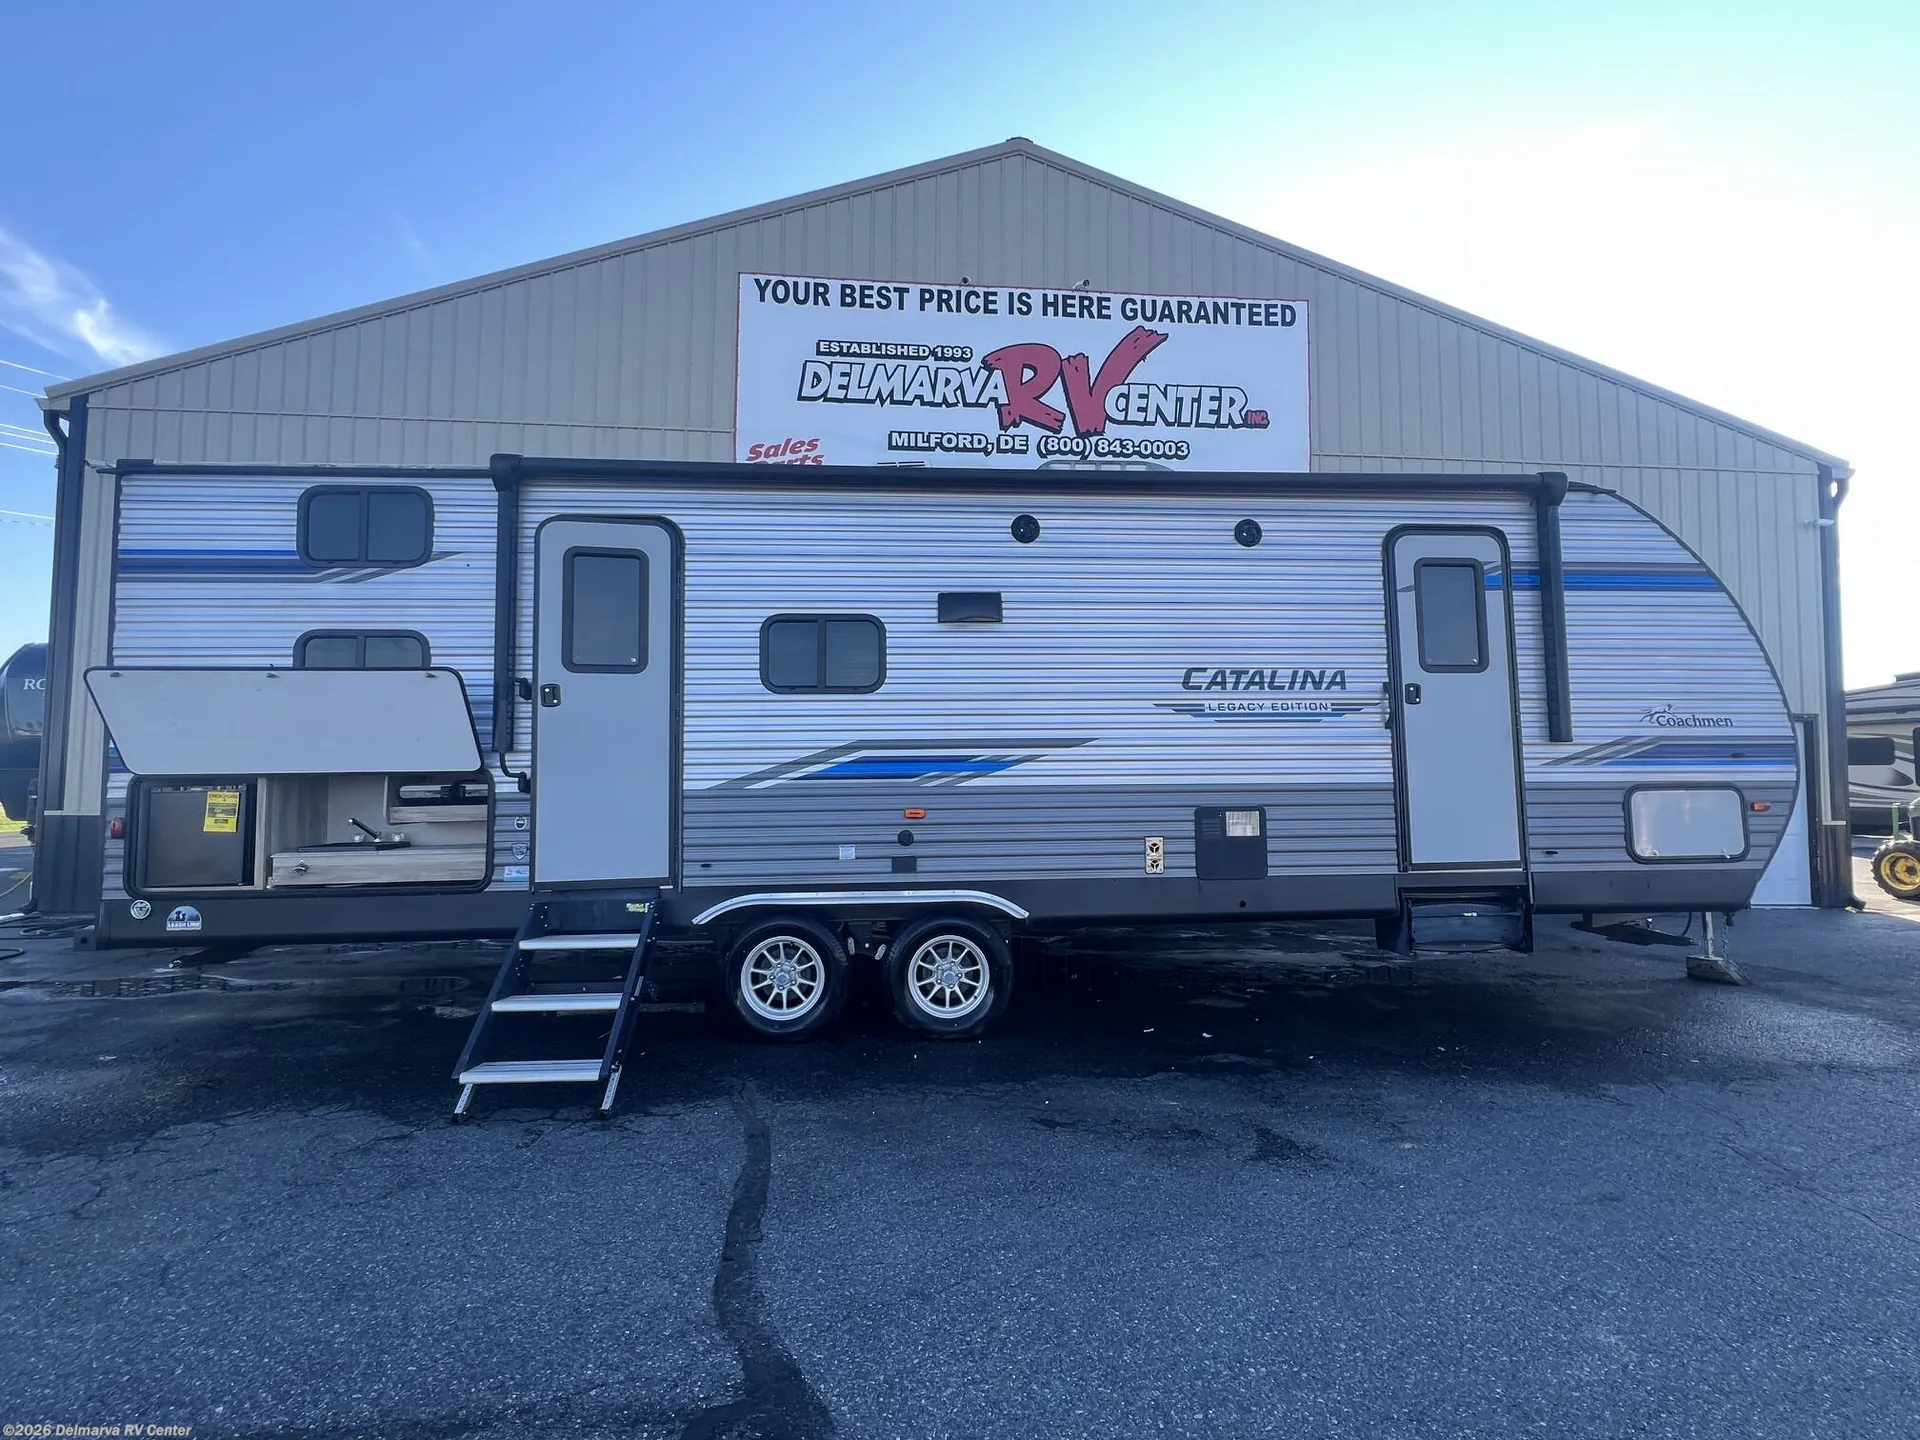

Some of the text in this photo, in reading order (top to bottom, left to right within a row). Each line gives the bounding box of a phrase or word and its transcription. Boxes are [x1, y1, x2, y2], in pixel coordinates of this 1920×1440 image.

[754, 278, 1297, 327] YOUR BEST PRICE IS HERE GUARANTEED
[817, 340, 973, 360] ESTABLISHED 1993
[797, 360, 1011, 408] DELMARVA
[981, 325, 1169, 436] RV
[1104, 383, 1248, 428] CENTER
[746, 438, 820, 461] Sales
[889, 431, 1191, 460] MILFORD, DE (800) 843-0003
[1181, 667, 1347, 691] CATALINA
[1208, 702, 1329, 712] LEGACY EDITION
[1656, 714, 1734, 728] Coachmen
